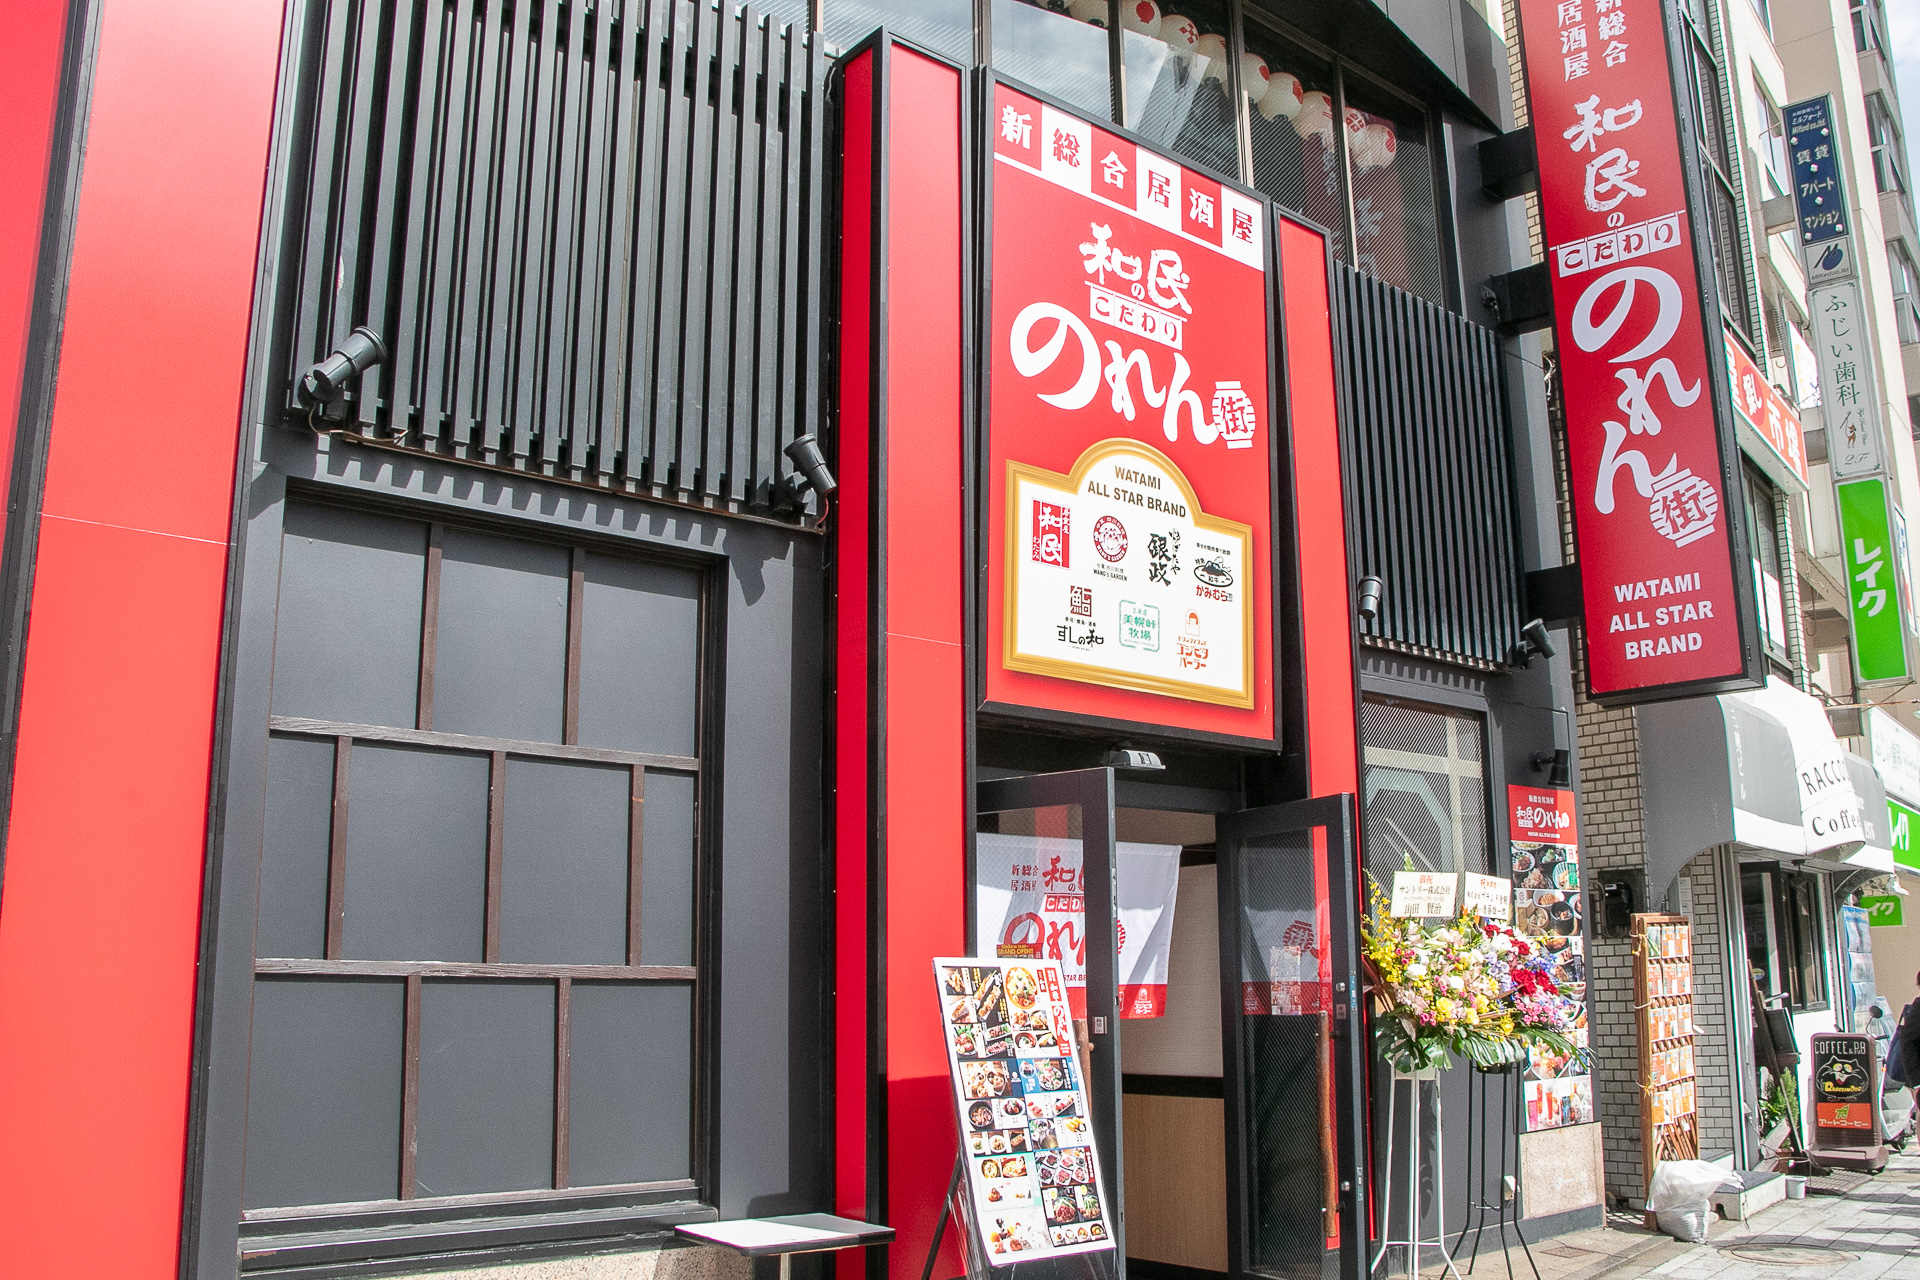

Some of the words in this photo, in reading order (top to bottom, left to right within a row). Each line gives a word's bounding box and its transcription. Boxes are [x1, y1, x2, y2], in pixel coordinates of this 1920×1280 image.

[1557, 0, 1590, 82] 居酒屋
[1796, 144, 1829, 165] 賃貸
[1001, 105, 1253, 243] 新総合居酒屋
[1800, 177, 1834, 197] アパート
[1804, 210, 1839, 229] マンション
[1564, 223, 1674, 271] こだわり
[1094, 296, 1178, 342] こだわり
[1825, 295, 1861, 407] ふじい歯科
[1010, 301, 1256, 449] のれん街
[1571, 266, 1718, 548] のれん街
[1115, 465, 1161, 490] WATAMI
[1088, 481, 1110, 498] ALL
[1114, 488, 1143, 506] STAR
[1147, 496, 1187, 518] BRAND
[1038, 506, 1062, 563] 和民
[1148, 533, 1172, 586] 銀政
[1854, 538, 1886, 618] レイク
[1614, 572, 1701, 602] WATAMI
[1609, 611, 1650, 633] ALL
[1655, 600, 1714, 626] STAR
[1180, 657, 1207, 670] パーラー
[1624, 632, 1703, 660] BRAND
[1046, 897, 1084, 910] こだわ
[1819, 1119, 1869, 1127] アートコーヒー
